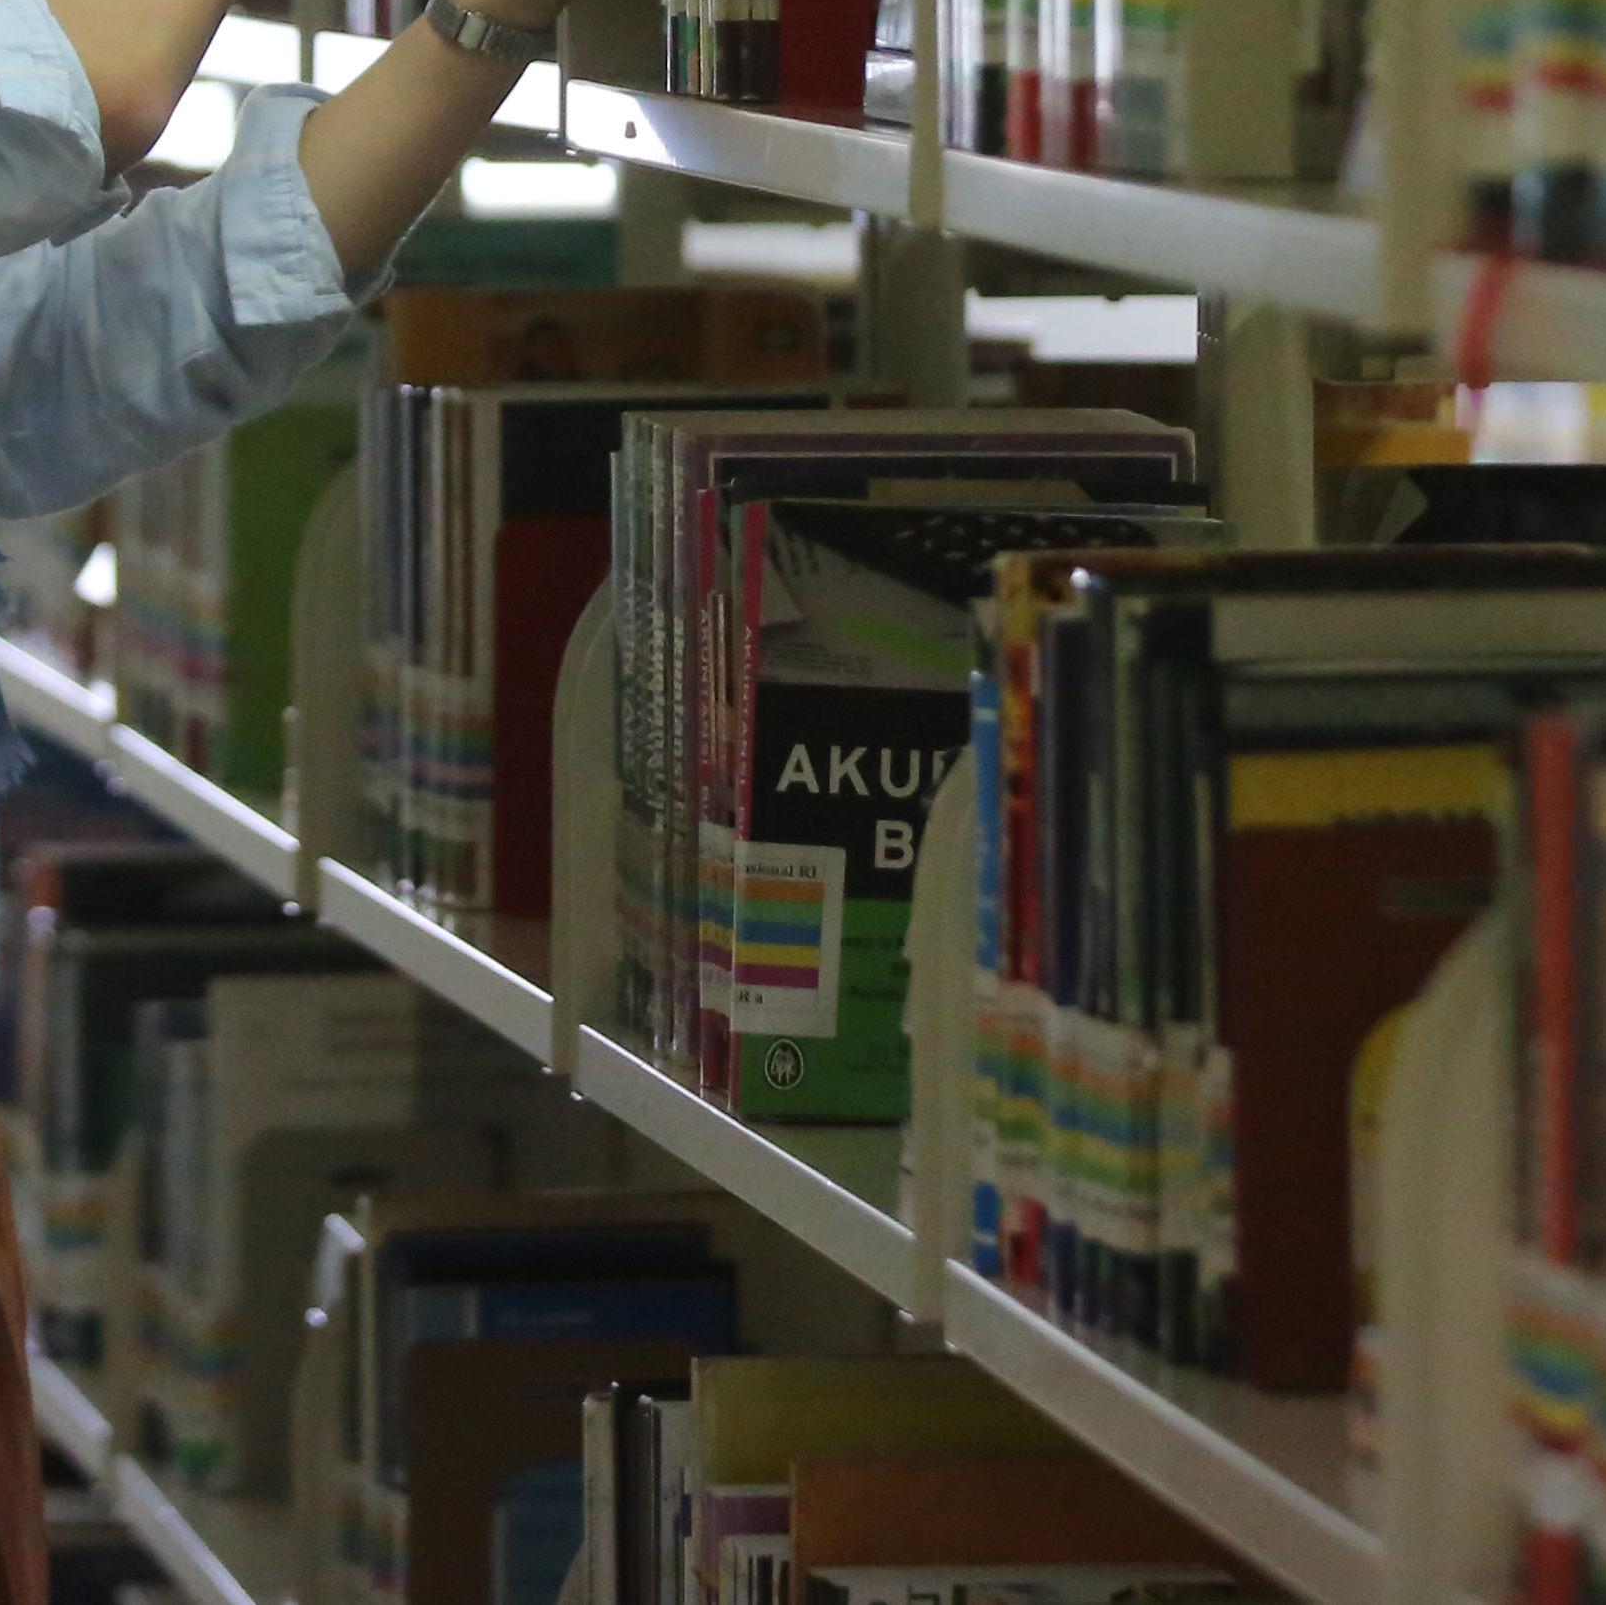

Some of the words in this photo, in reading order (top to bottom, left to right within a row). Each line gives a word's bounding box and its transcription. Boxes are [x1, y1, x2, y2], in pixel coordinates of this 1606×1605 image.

[700, 608, 711, 765] AKUNTANSI
[740, 624, 753, 784] AKUNTANSI
[874, 819, 915, 869] B
